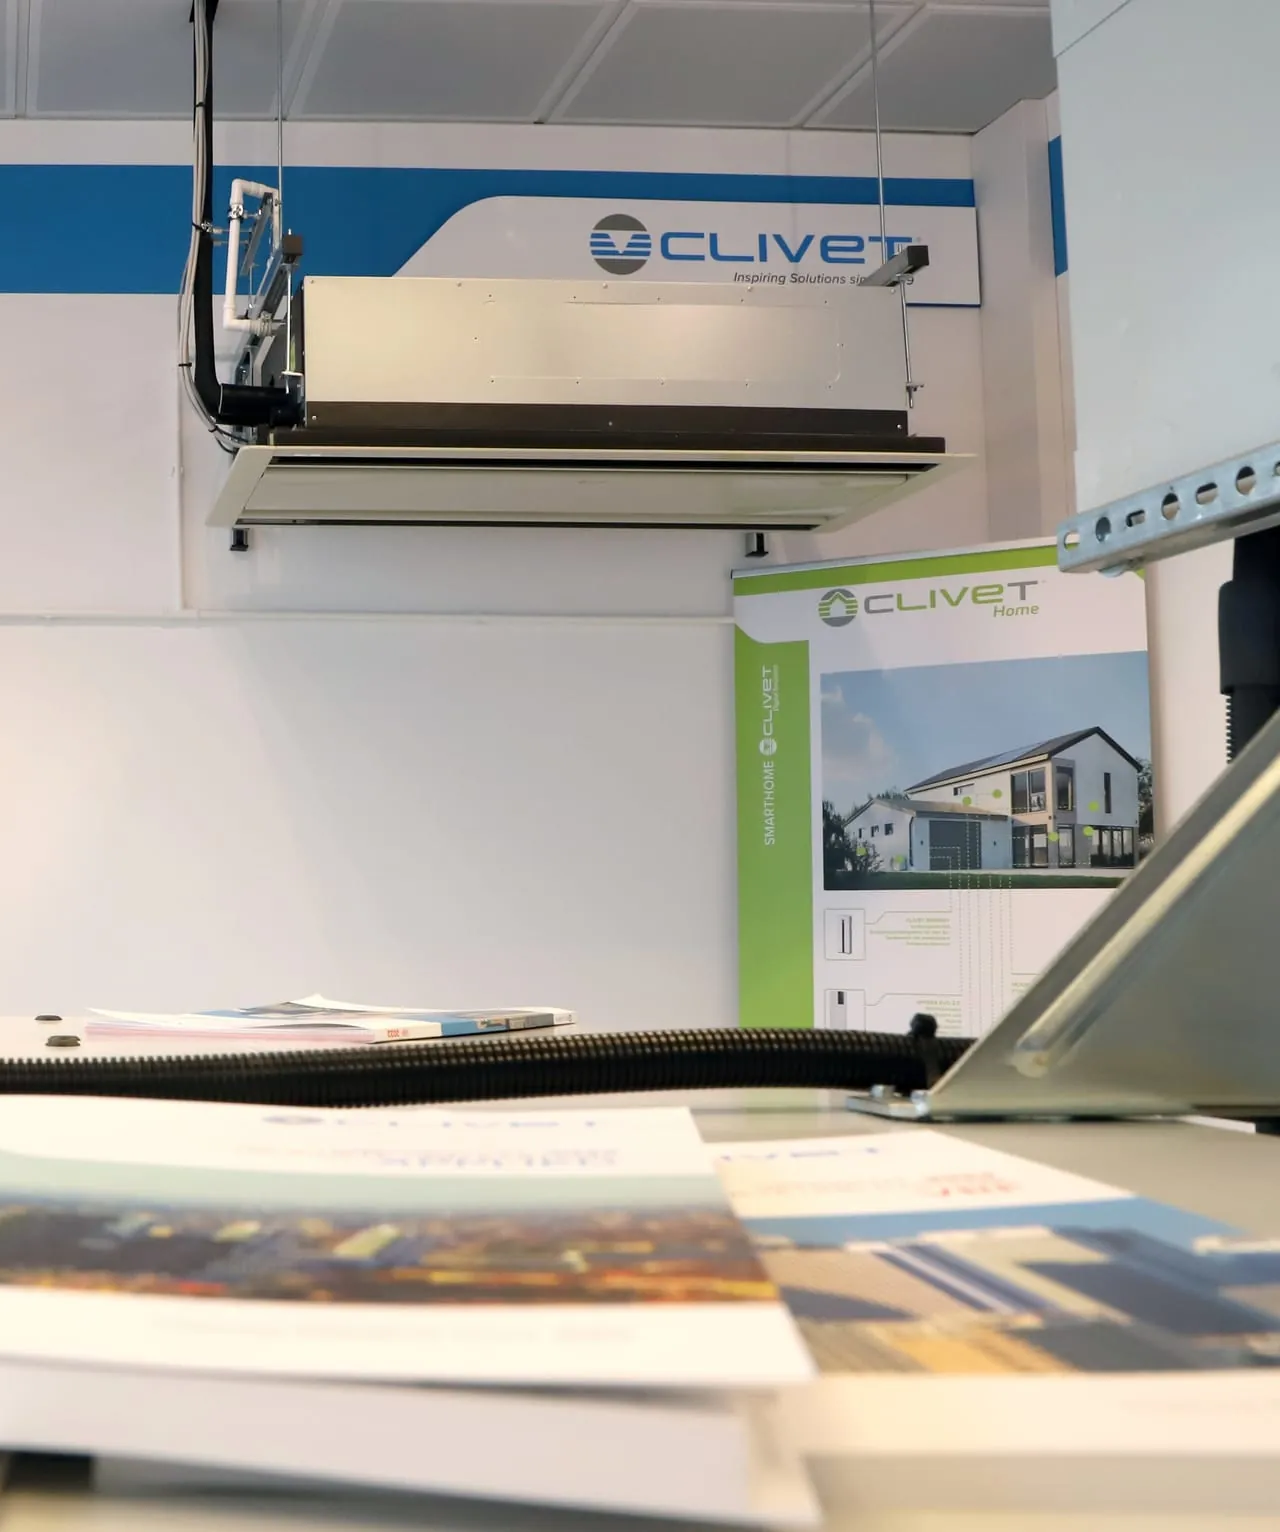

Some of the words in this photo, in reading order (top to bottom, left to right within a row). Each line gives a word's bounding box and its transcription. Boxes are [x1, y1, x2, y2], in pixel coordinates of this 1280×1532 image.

[733, 271, 786, 286] Inspiring
[789, 272, 847, 285] Solutions
[993, 602, 1040, 618] Home
[764, 760, 775, 846] SMARTHOME
